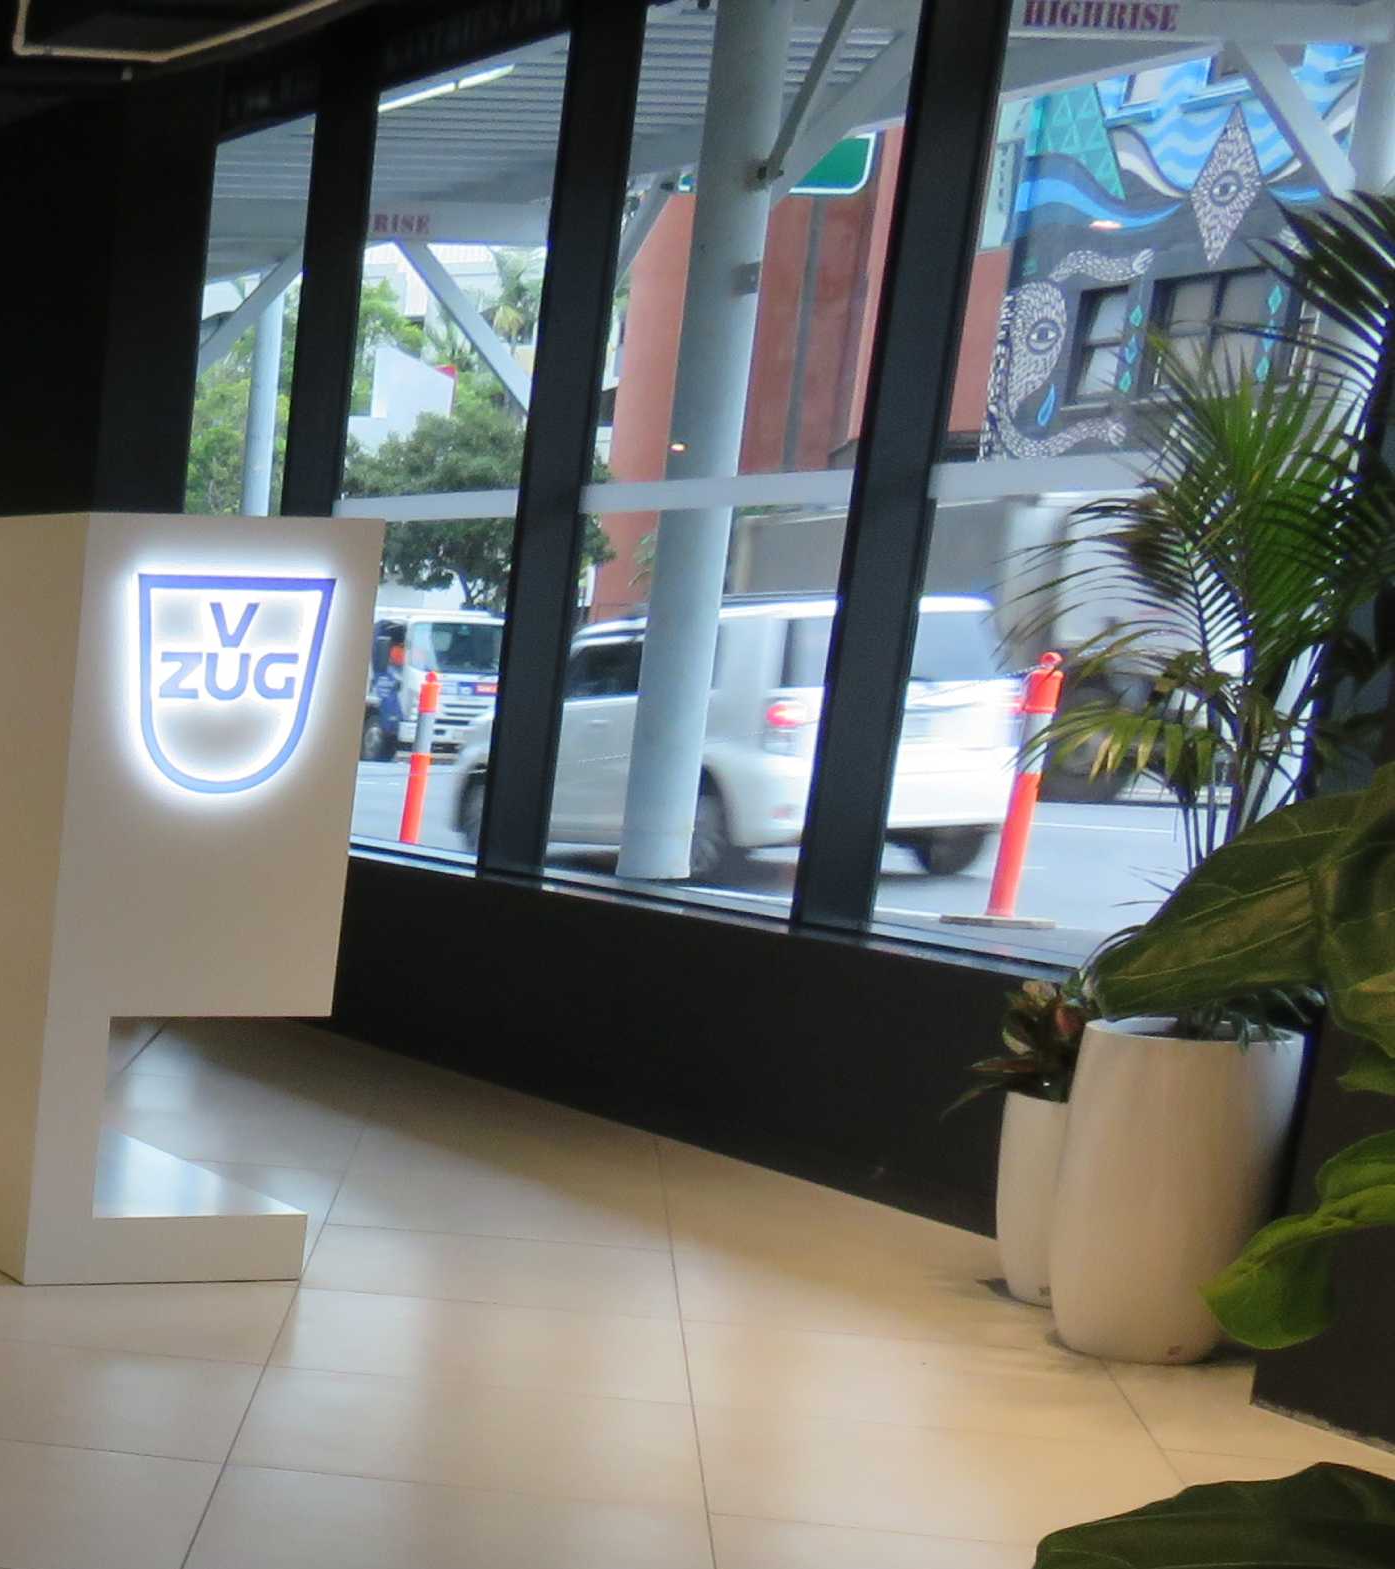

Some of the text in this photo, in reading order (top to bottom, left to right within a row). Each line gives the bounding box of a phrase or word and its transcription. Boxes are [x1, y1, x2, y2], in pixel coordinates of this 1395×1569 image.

[371, 213, 429, 233] RISE
[210, 602, 261, 648] V
[158, 651, 300, 701] ZUG
